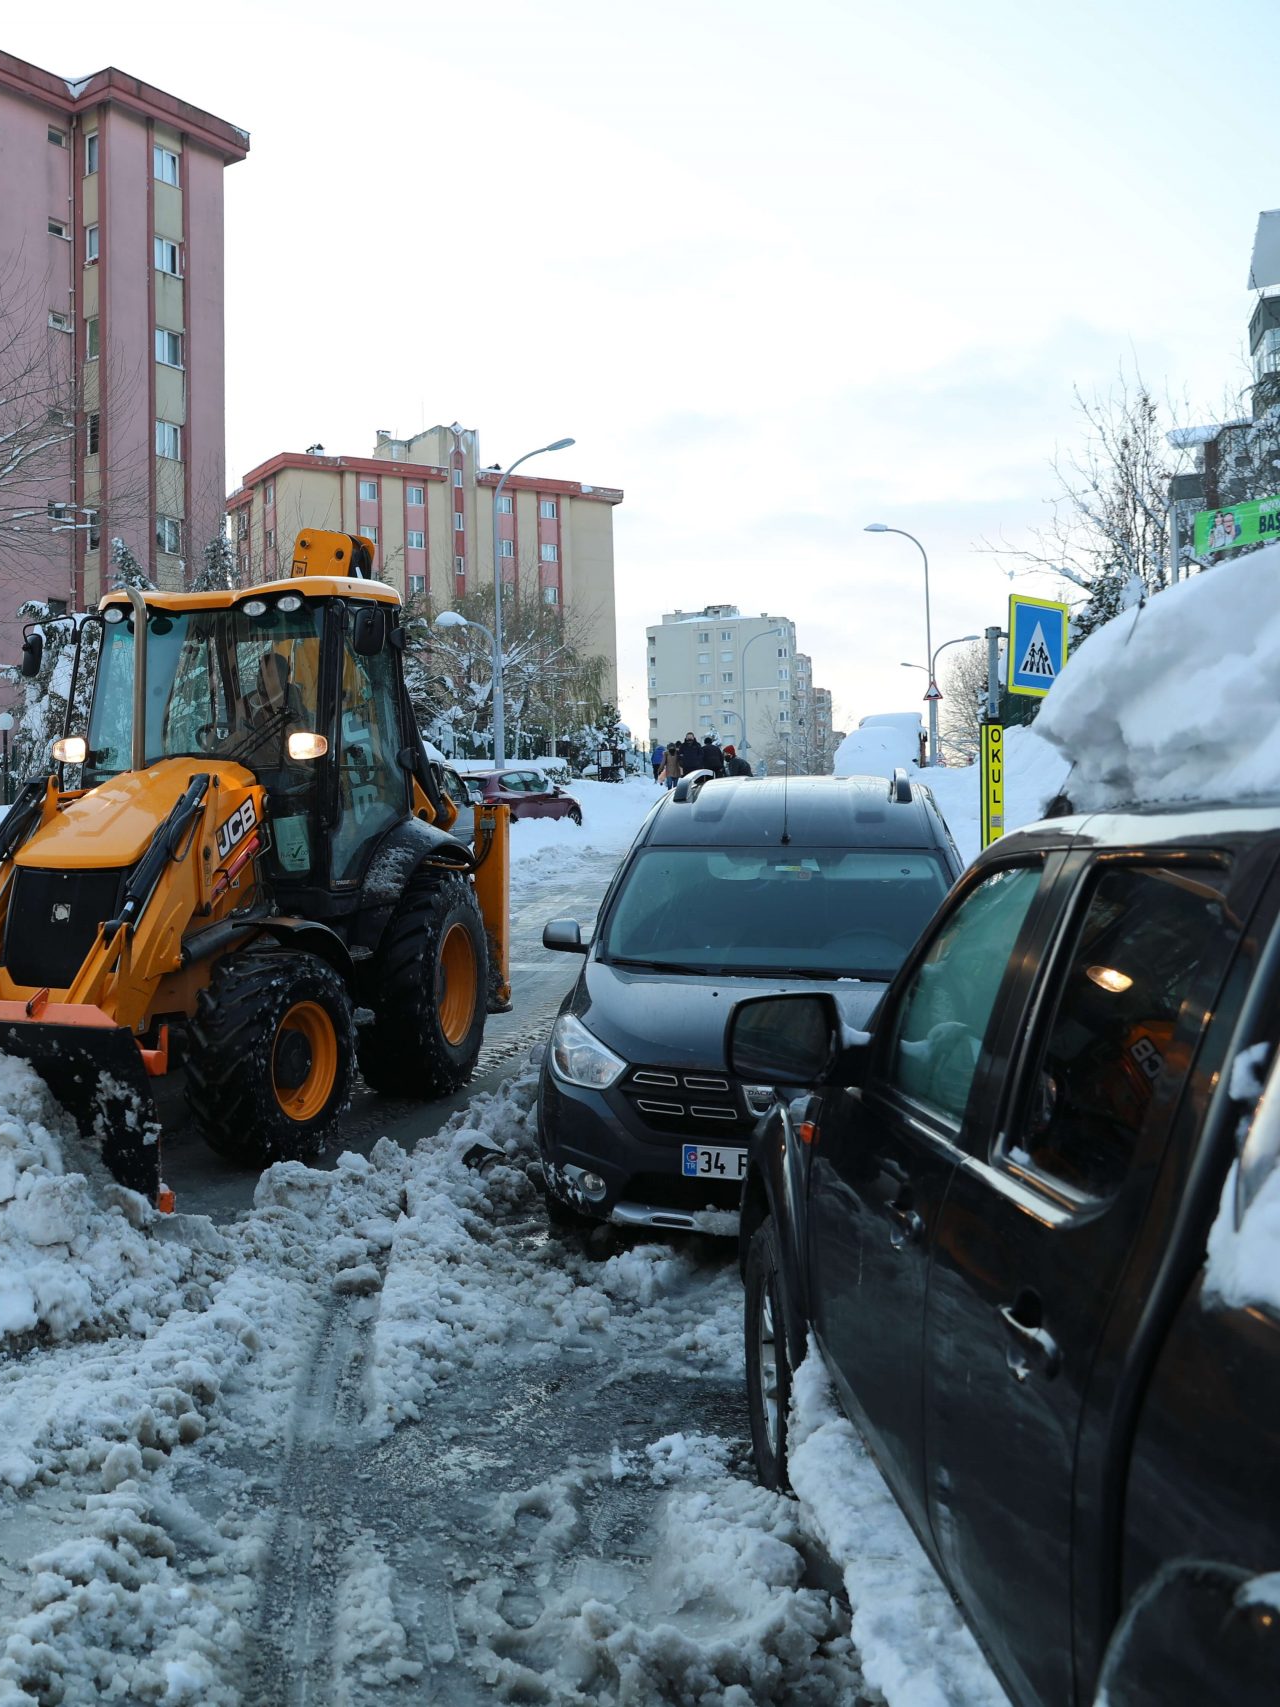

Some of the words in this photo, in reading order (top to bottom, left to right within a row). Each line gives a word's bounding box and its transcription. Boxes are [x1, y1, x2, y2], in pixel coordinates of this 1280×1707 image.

[990, 728, 1002, 804] OKUL
[220, 798, 256, 857] JCB
[685, 1162, 696, 1170] TR
[700, 1151, 726, 1174] 34
